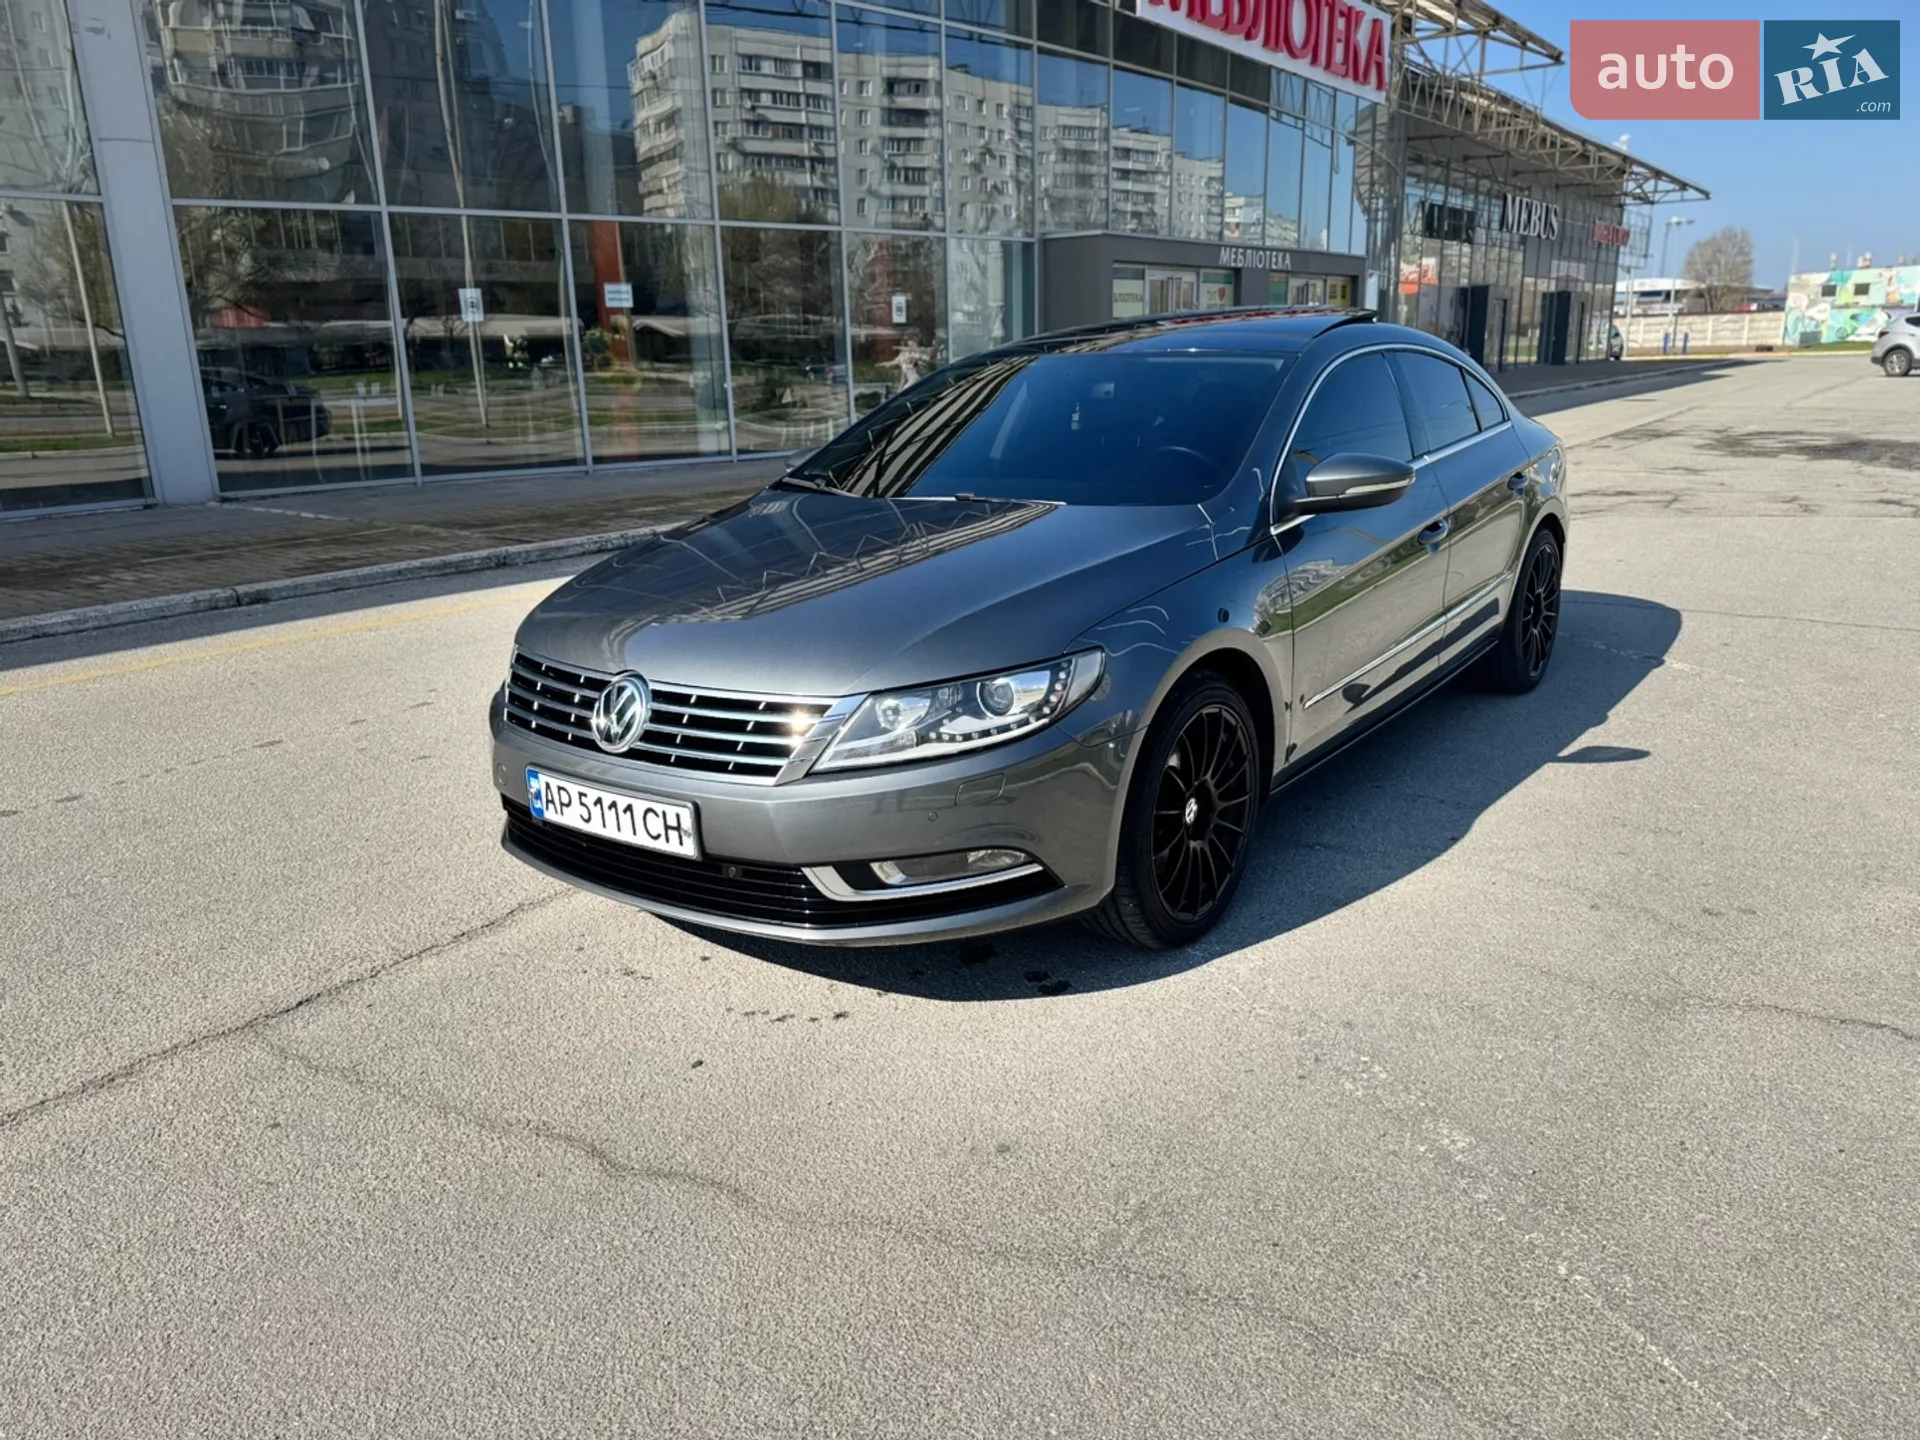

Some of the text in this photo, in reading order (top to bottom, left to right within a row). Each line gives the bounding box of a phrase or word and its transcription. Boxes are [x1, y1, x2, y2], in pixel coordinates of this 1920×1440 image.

[1502, 193, 1560, 240] MEBUS
[1218, 246, 1292, 271] МЕБЛІОТЕКА
[544, 781, 684, 847] AP 5111 CH
